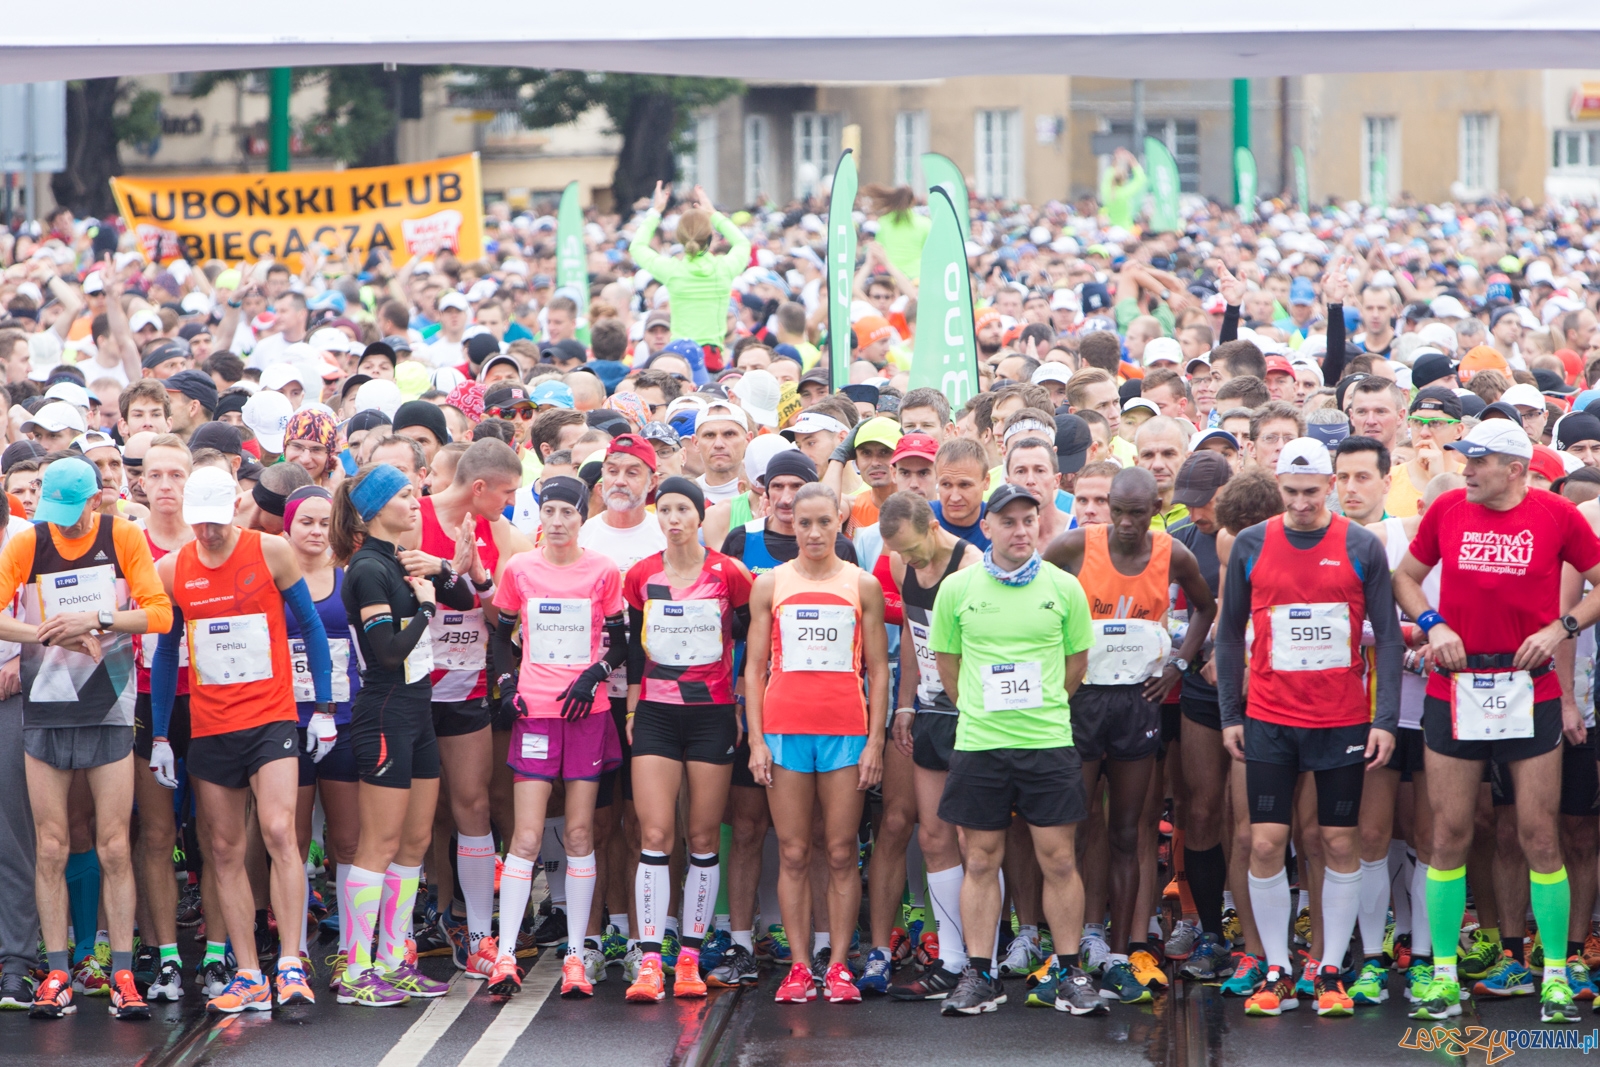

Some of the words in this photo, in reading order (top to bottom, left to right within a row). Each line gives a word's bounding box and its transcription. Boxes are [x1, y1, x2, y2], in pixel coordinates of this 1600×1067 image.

[127, 178, 334, 221] LUBOŃSKI
[351, 173, 462, 212] KLUB
[180, 222, 395, 260] BIEGACZA
[1462, 530, 1521, 547] DRUŻYNA
[1458, 543, 1534, 564] SZPIKU
[1458, 563, 1527, 576] www.darszpiku.pl
[56, 578, 77, 586] 17.PKO
[58, 592, 102, 606] Pobłocki
[1093, 598, 1113, 615] Run
[536, 622, 585, 632] Kucharska
[653, 624, 716, 634] Parszczyńska
[1291, 626, 1332, 641] 5915
[438, 631, 480, 645] 4393
[798, 627, 838, 642] 2190
[216, 642, 247, 651] Fehlau
[448, 646, 468, 654] Jakub
[1106, 644, 1144, 653] Dickson
[1000, 679, 1030, 695] 314
[1004, 696, 1028, 705] Tomek
[1482, 695, 1507, 709] 46
